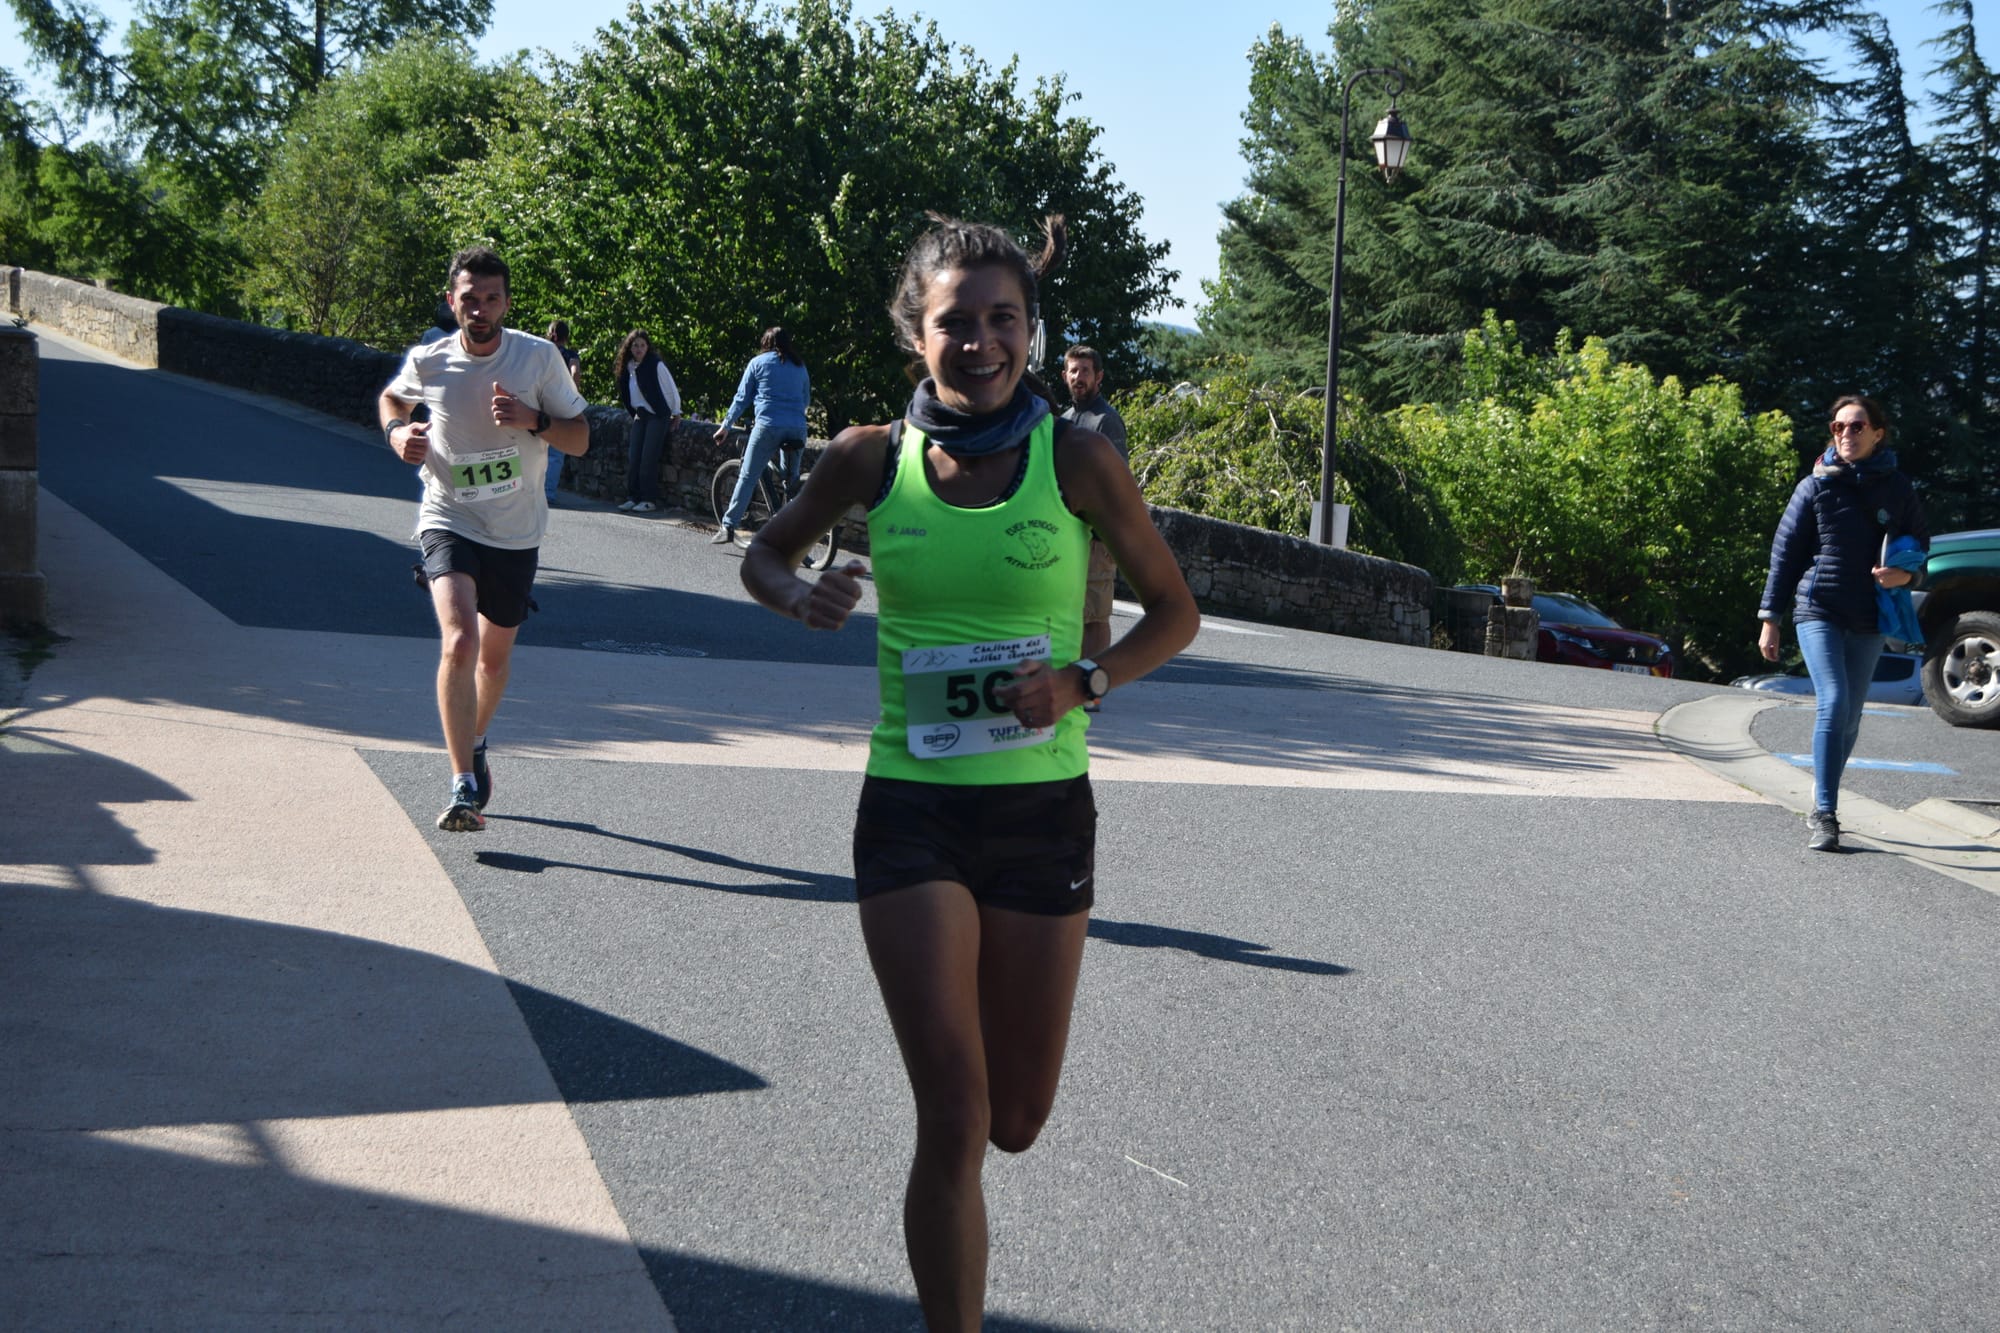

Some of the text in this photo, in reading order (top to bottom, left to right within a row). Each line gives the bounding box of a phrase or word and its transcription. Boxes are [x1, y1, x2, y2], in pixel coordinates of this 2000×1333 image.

[462, 461, 512, 486] 113
[898, 524, 927, 536] JAKO
[973, 643, 1020, 654] Challenge
